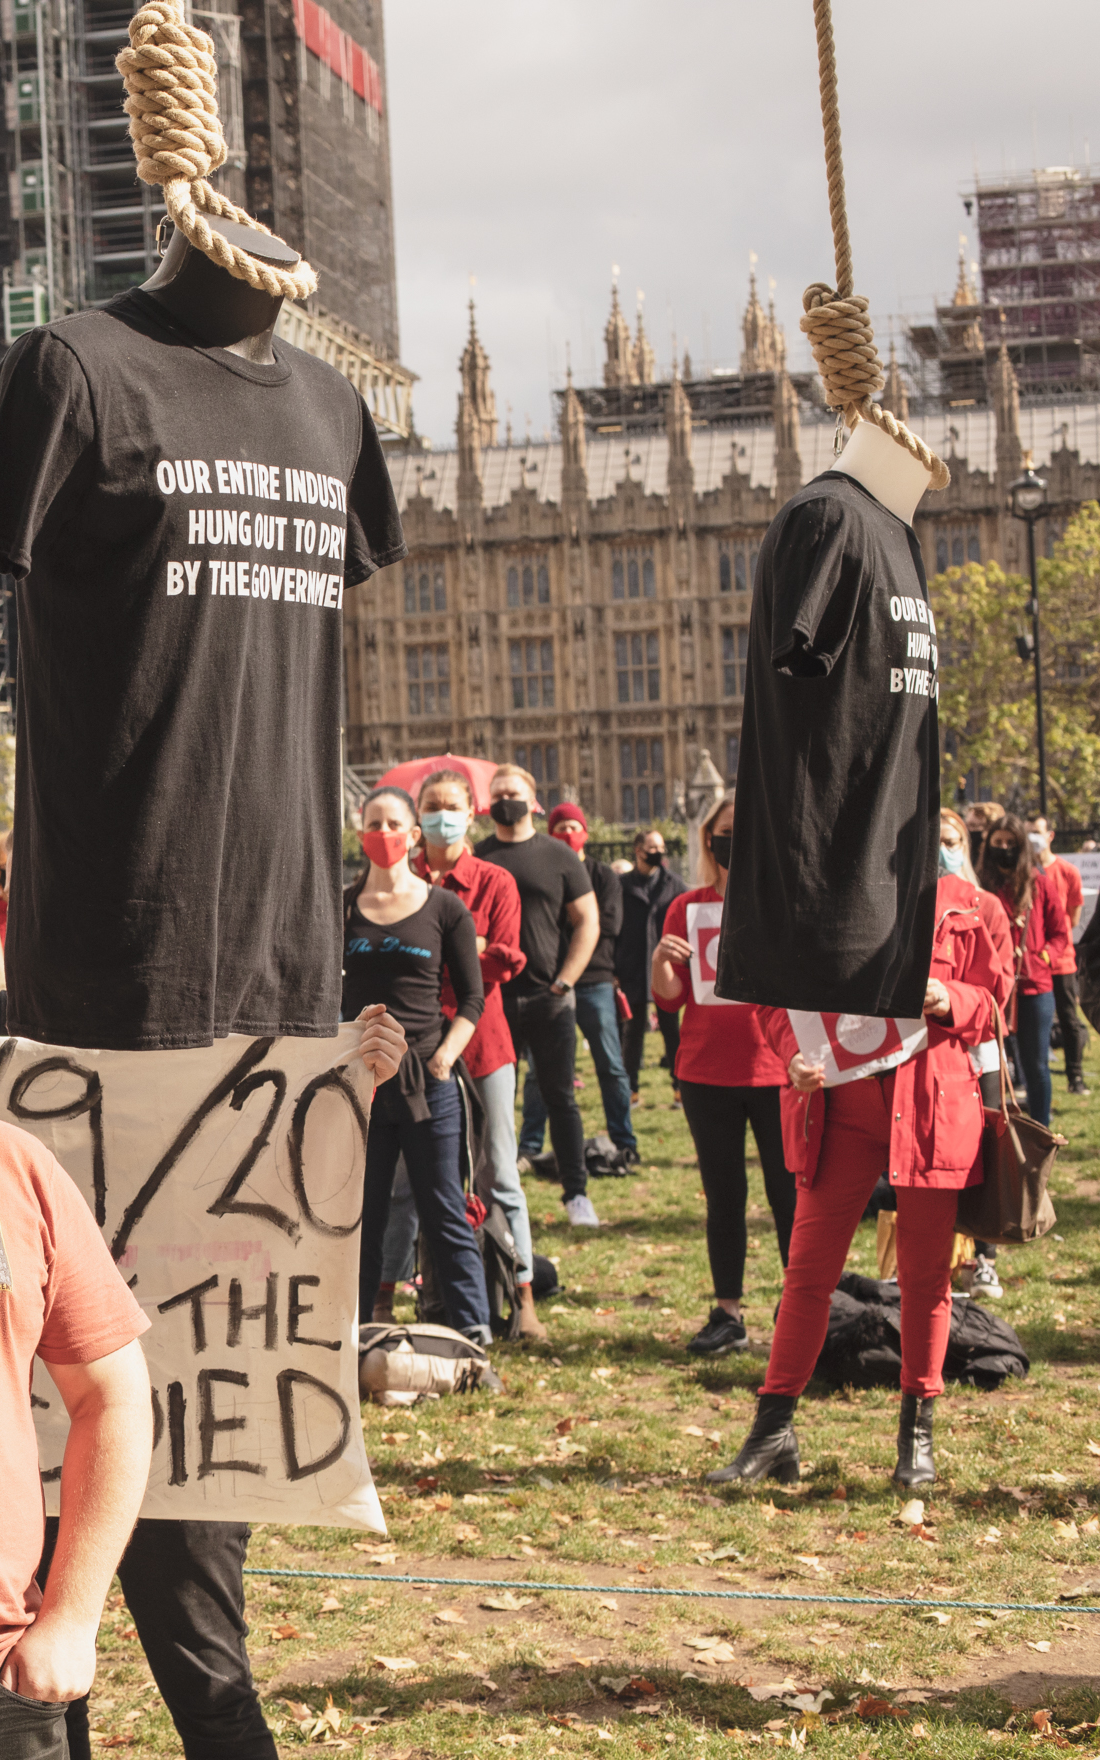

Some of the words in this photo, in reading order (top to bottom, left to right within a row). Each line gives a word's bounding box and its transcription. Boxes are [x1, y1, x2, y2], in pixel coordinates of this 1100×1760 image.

[156, 459, 213, 494] OUR
[215, 459, 281, 501] ENTIRE
[188, 509, 252, 546] HUNG
[254, 513, 288, 551] OUT
[293, 518, 317, 555] TO
[318, 522, 346, 561] DRY
[166, 560, 202, 596] BY
[208, 560, 250, 597] THE
[890, 595, 918, 622] OUR
[907, 631, 931, 661] HUNG
[889, 667, 913, 694] BY
[910, 668, 929, 696] THE
[157, 1271, 343, 1355] THE
